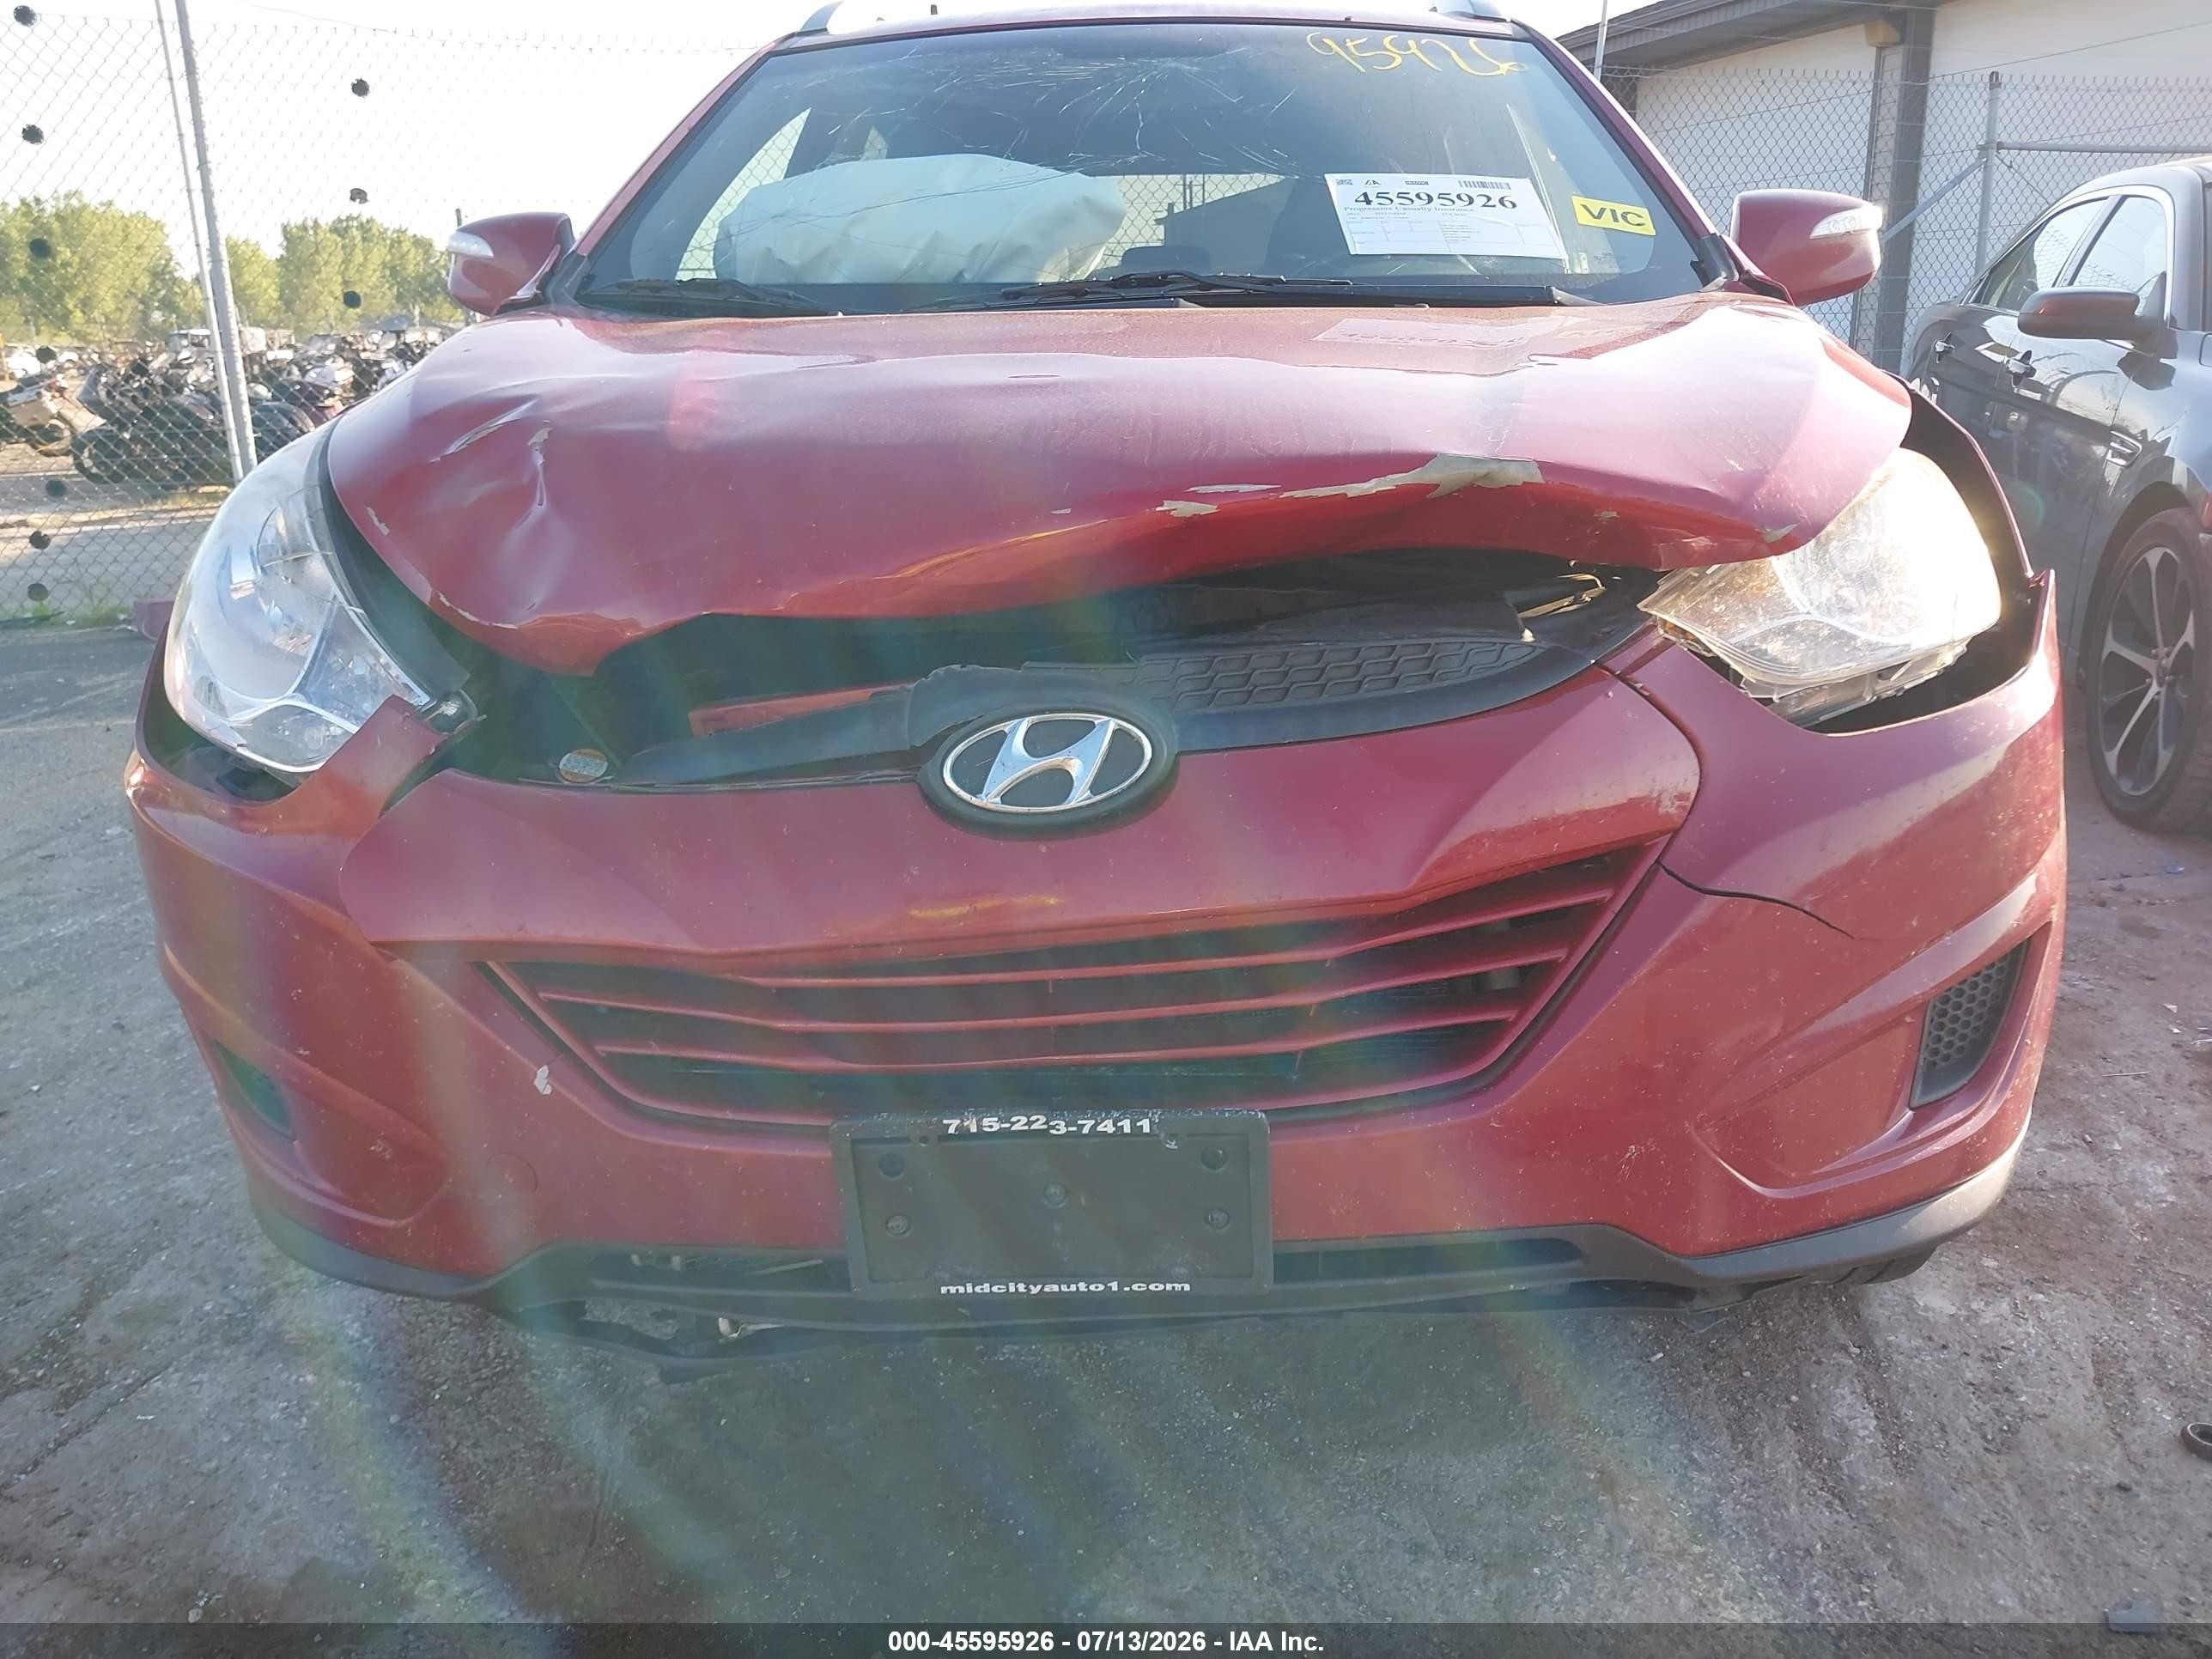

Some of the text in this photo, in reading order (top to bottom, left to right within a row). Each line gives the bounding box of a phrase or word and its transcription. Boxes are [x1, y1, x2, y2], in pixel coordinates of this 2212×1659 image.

[1354, 191, 1518, 210] 45595926
[1580, 204, 1646, 227] VIC
[943, 1115, 1152, 1135] 715-223-7411
[939, 1280, 1191, 1295] midcityauto1.com
